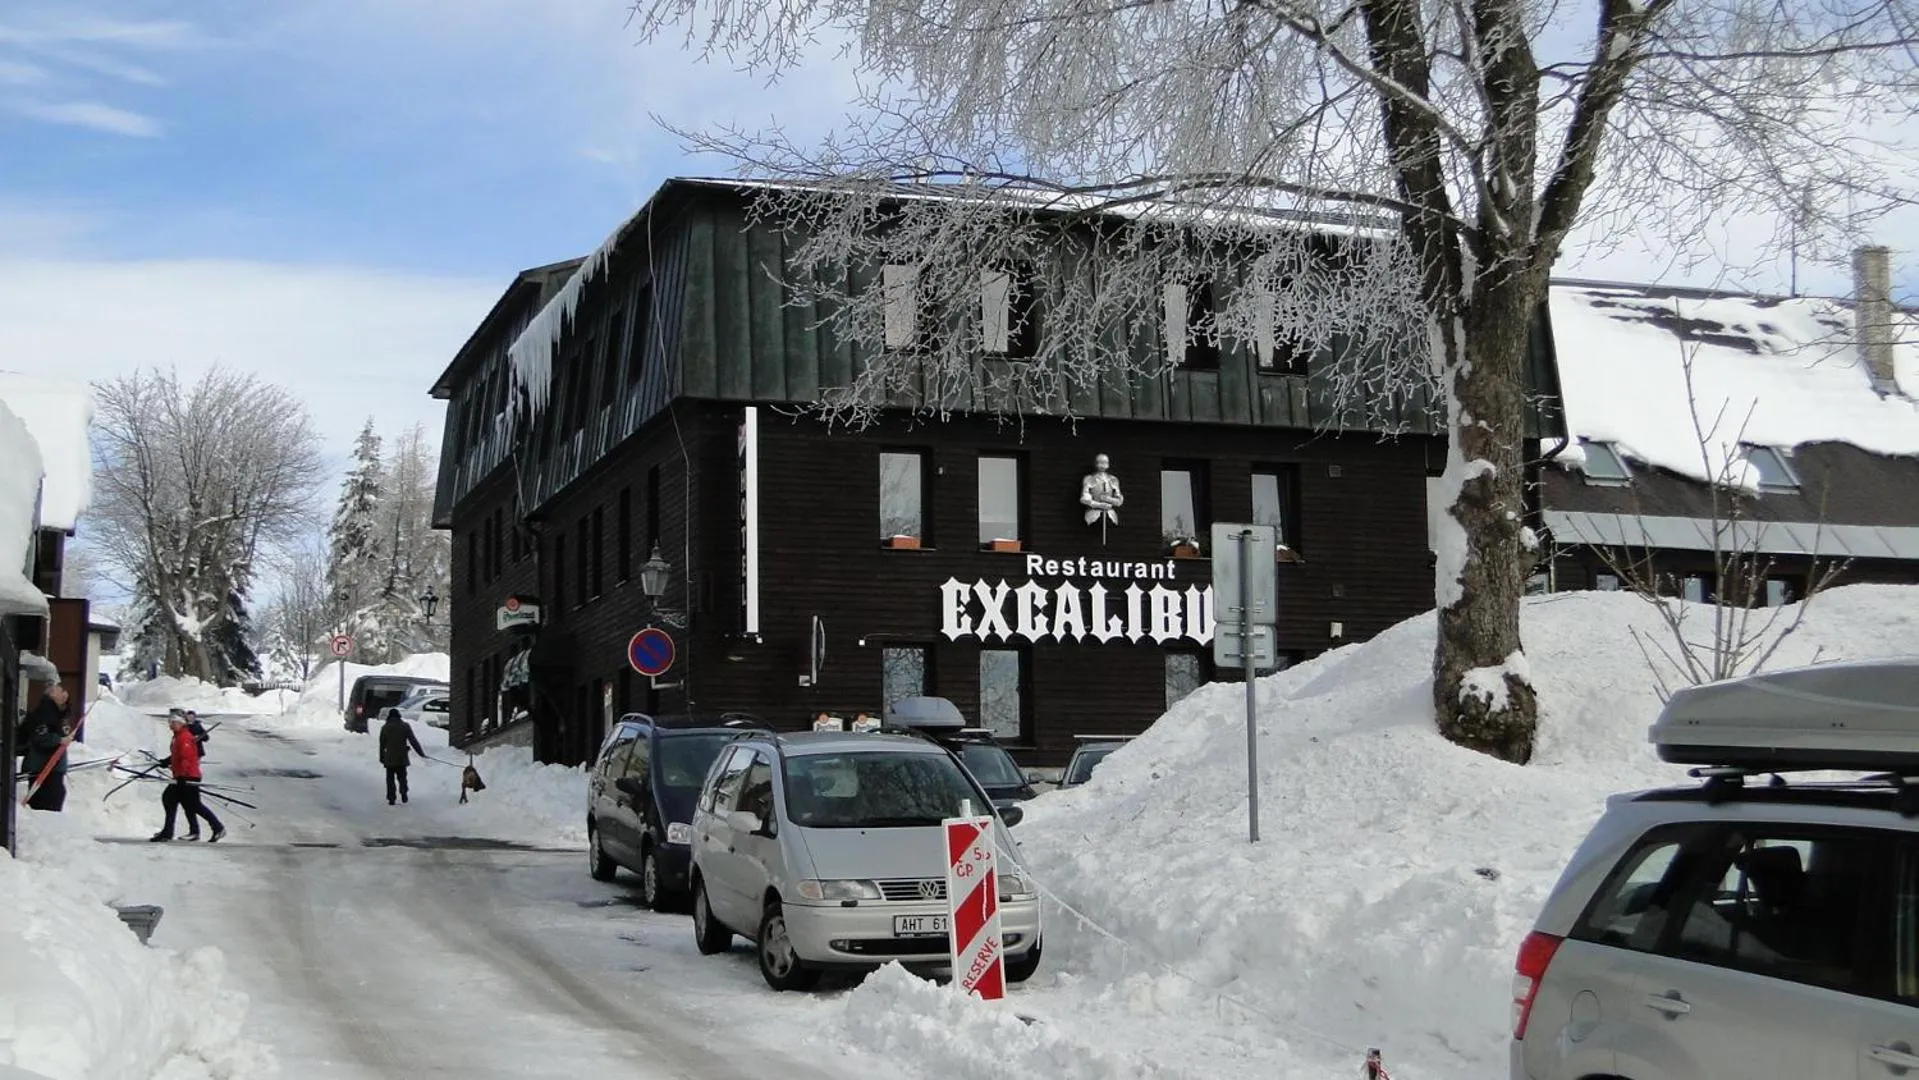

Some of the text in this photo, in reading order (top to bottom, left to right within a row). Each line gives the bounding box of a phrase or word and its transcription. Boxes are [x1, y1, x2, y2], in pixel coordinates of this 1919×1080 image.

[1026, 554, 1176, 579] Restaurant
[940, 576, 1217, 647] EXCALIBU
[902, 918, 948, 931] AHT 61
[962, 936, 999, 989] RESERVE
